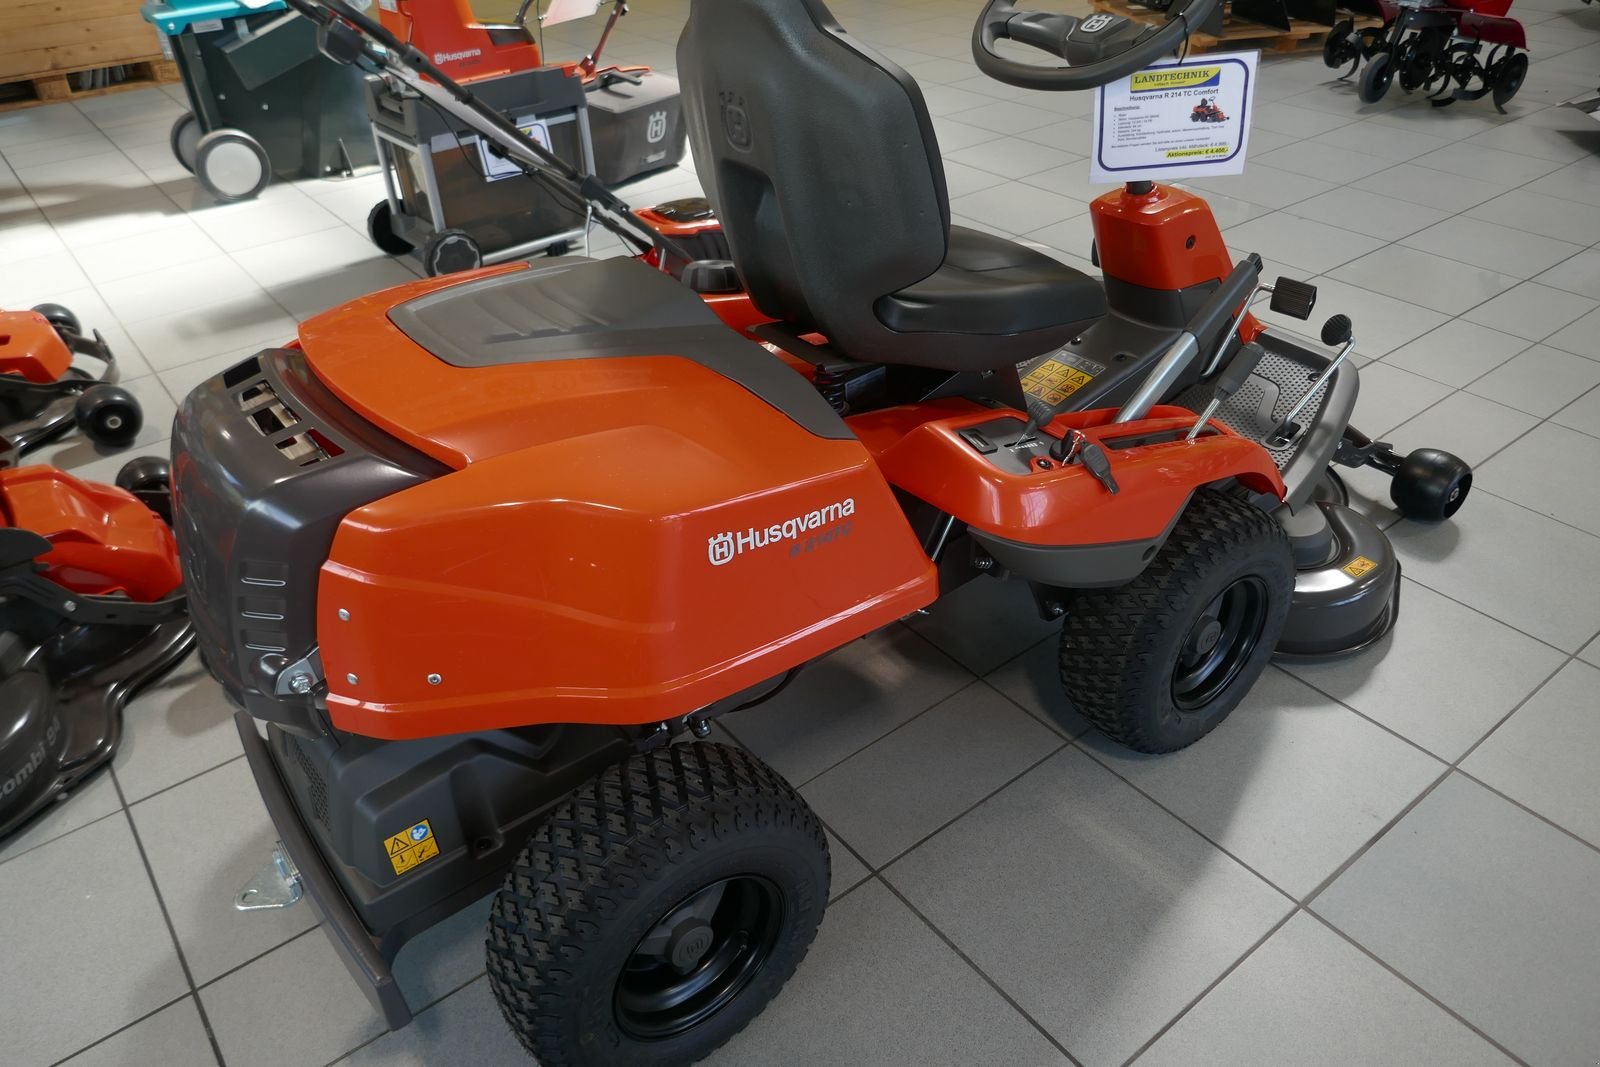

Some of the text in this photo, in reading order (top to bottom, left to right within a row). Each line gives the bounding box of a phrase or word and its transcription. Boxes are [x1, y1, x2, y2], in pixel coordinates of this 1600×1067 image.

[443, 49, 481, 61] Husqvarna
[1134, 70, 1210, 84] LANDTECHNIK
[1129, 93, 1163, 102] Husqvarna
[1194, 88, 1219, 96] Comfort
[736, 498, 855, 554] Husqvarna
